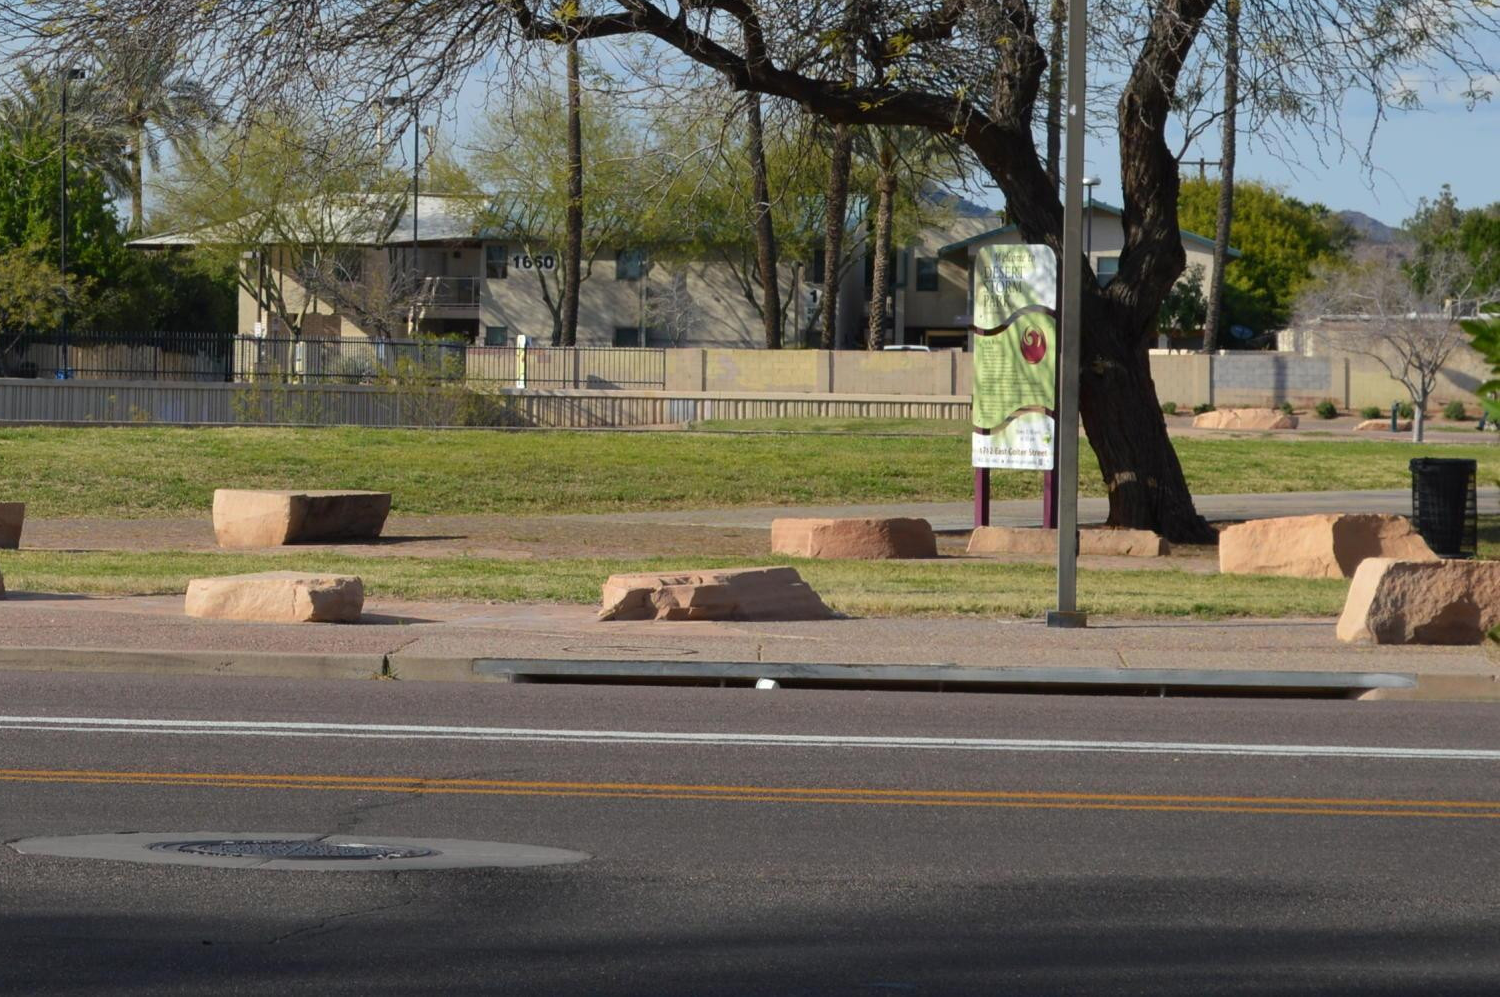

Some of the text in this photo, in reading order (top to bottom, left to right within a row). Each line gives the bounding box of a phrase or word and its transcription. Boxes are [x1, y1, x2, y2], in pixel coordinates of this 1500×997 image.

[984, 266, 1023, 279] DESERT
[984, 280, 1023, 294] STORM
[983, 294, 1011, 308] PARK
[994, 447, 1007, 456] East
[1028, 448, 1048, 457] Street
